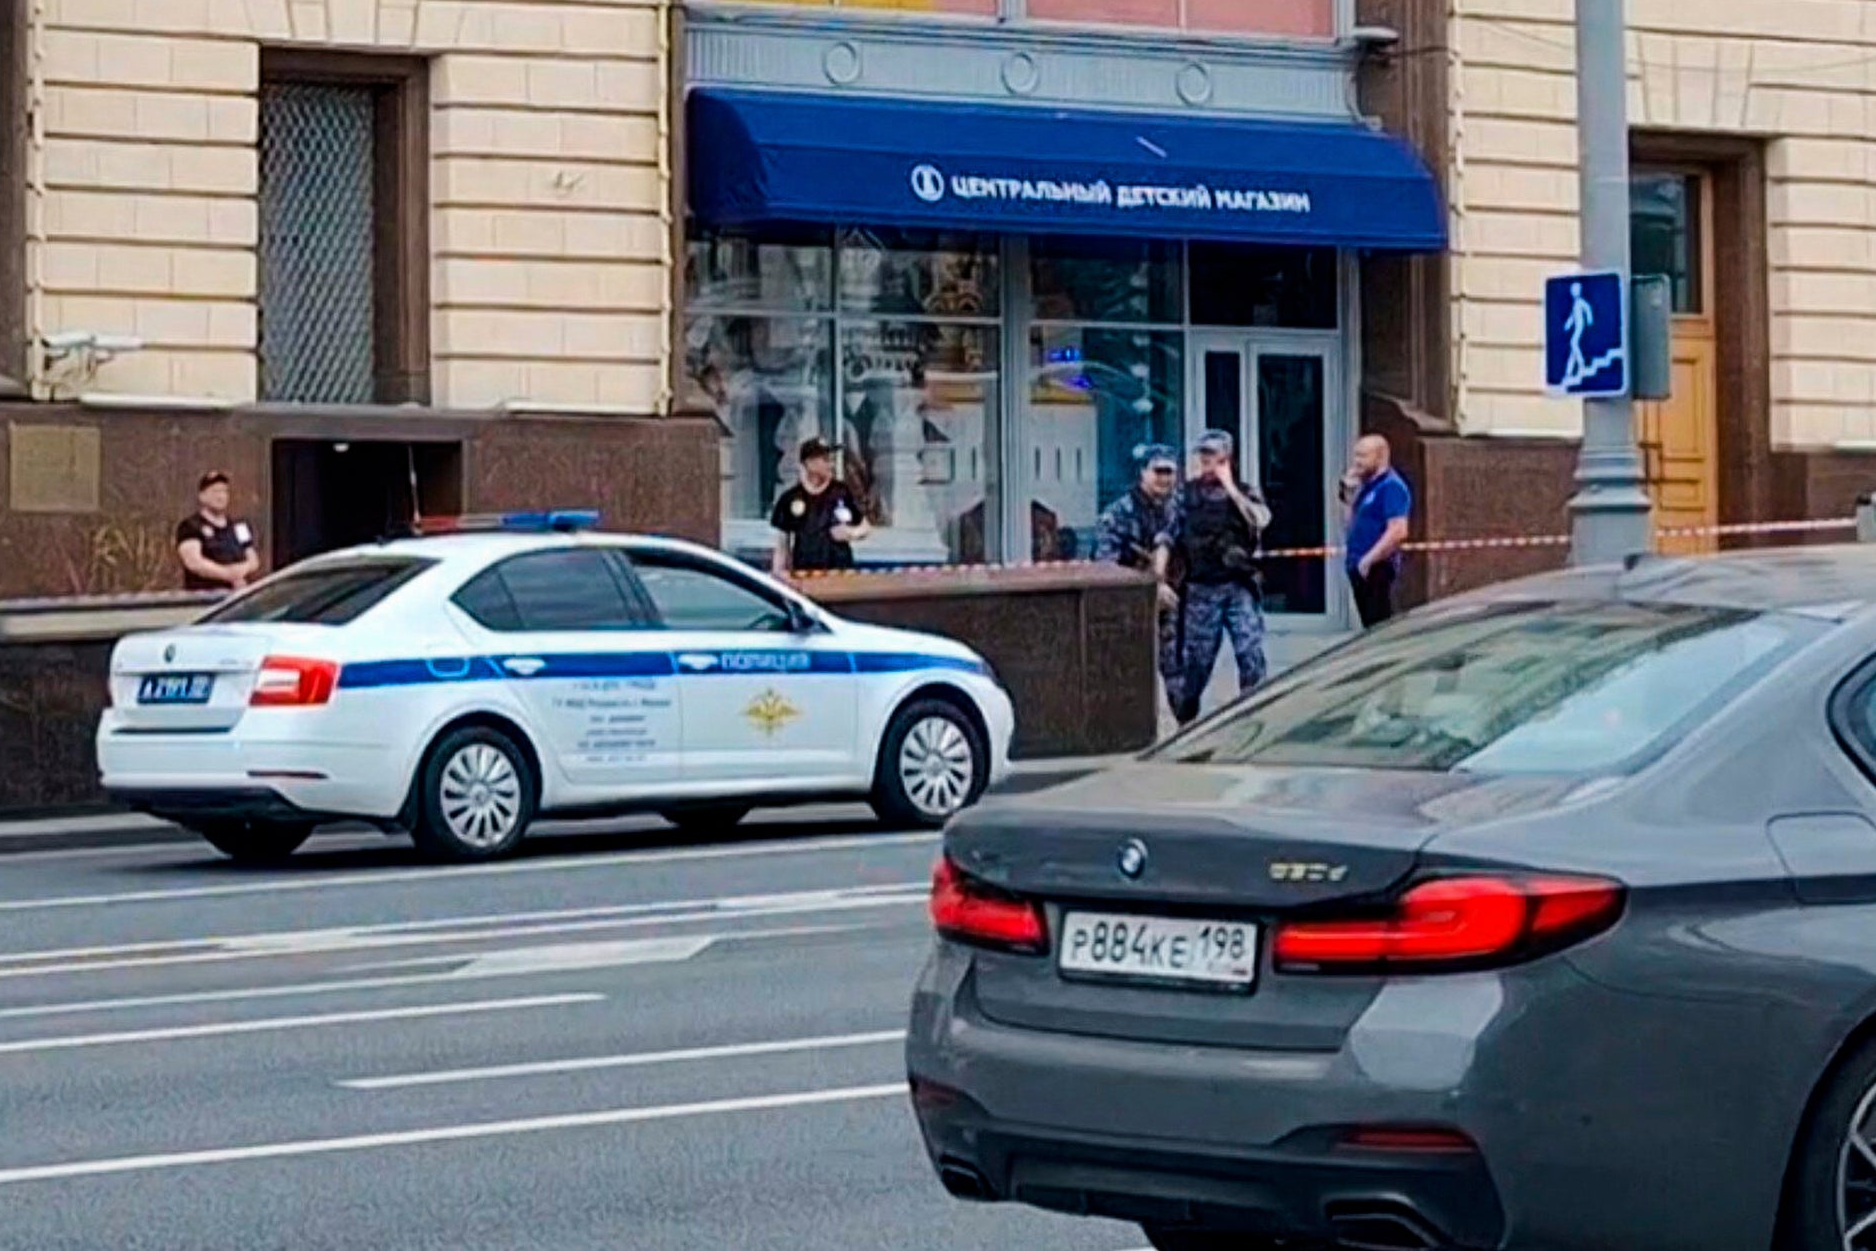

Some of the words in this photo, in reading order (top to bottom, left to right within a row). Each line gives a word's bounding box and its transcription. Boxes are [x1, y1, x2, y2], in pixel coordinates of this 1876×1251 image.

[950, 175, 1112, 205] ЦЕНТРАЛЬНЫЙ
[1117, 183, 1212, 210] ДЕТСКИЙ
[1215, 189, 1311, 213] МАГАЗИН
